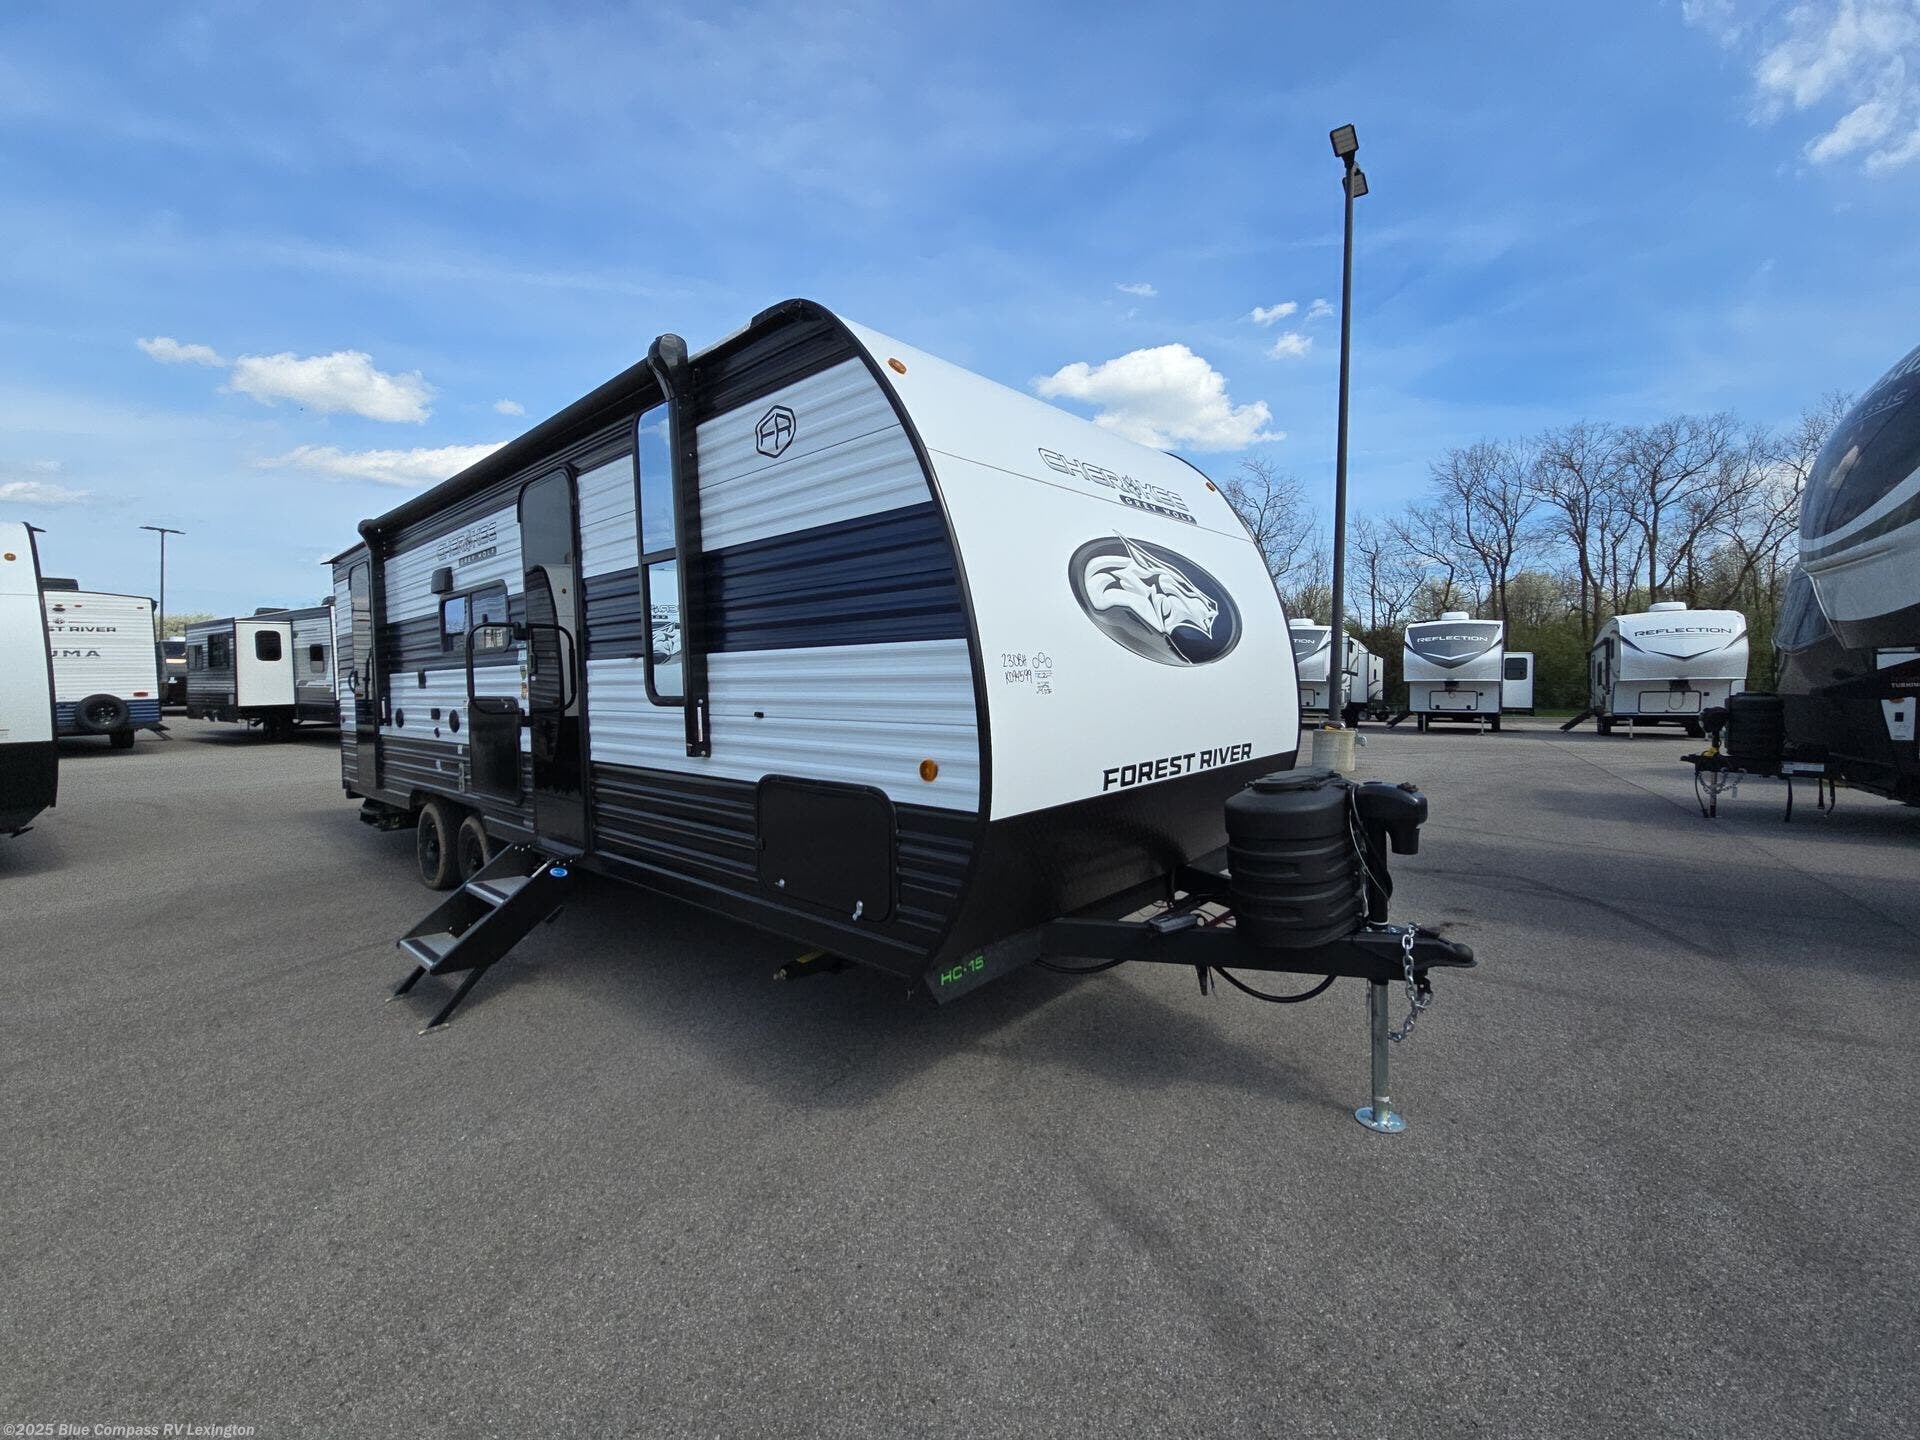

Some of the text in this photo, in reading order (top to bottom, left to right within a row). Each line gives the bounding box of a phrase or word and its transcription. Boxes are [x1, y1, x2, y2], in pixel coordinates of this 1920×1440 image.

[1125, 497, 1193, 522] GREY WOLF
[1417, 635, 1489, 643] REFLECTION
[1634, 627, 1732, 637] REFLECTION
[1102, 742, 1252, 792] FOREST RIVER
